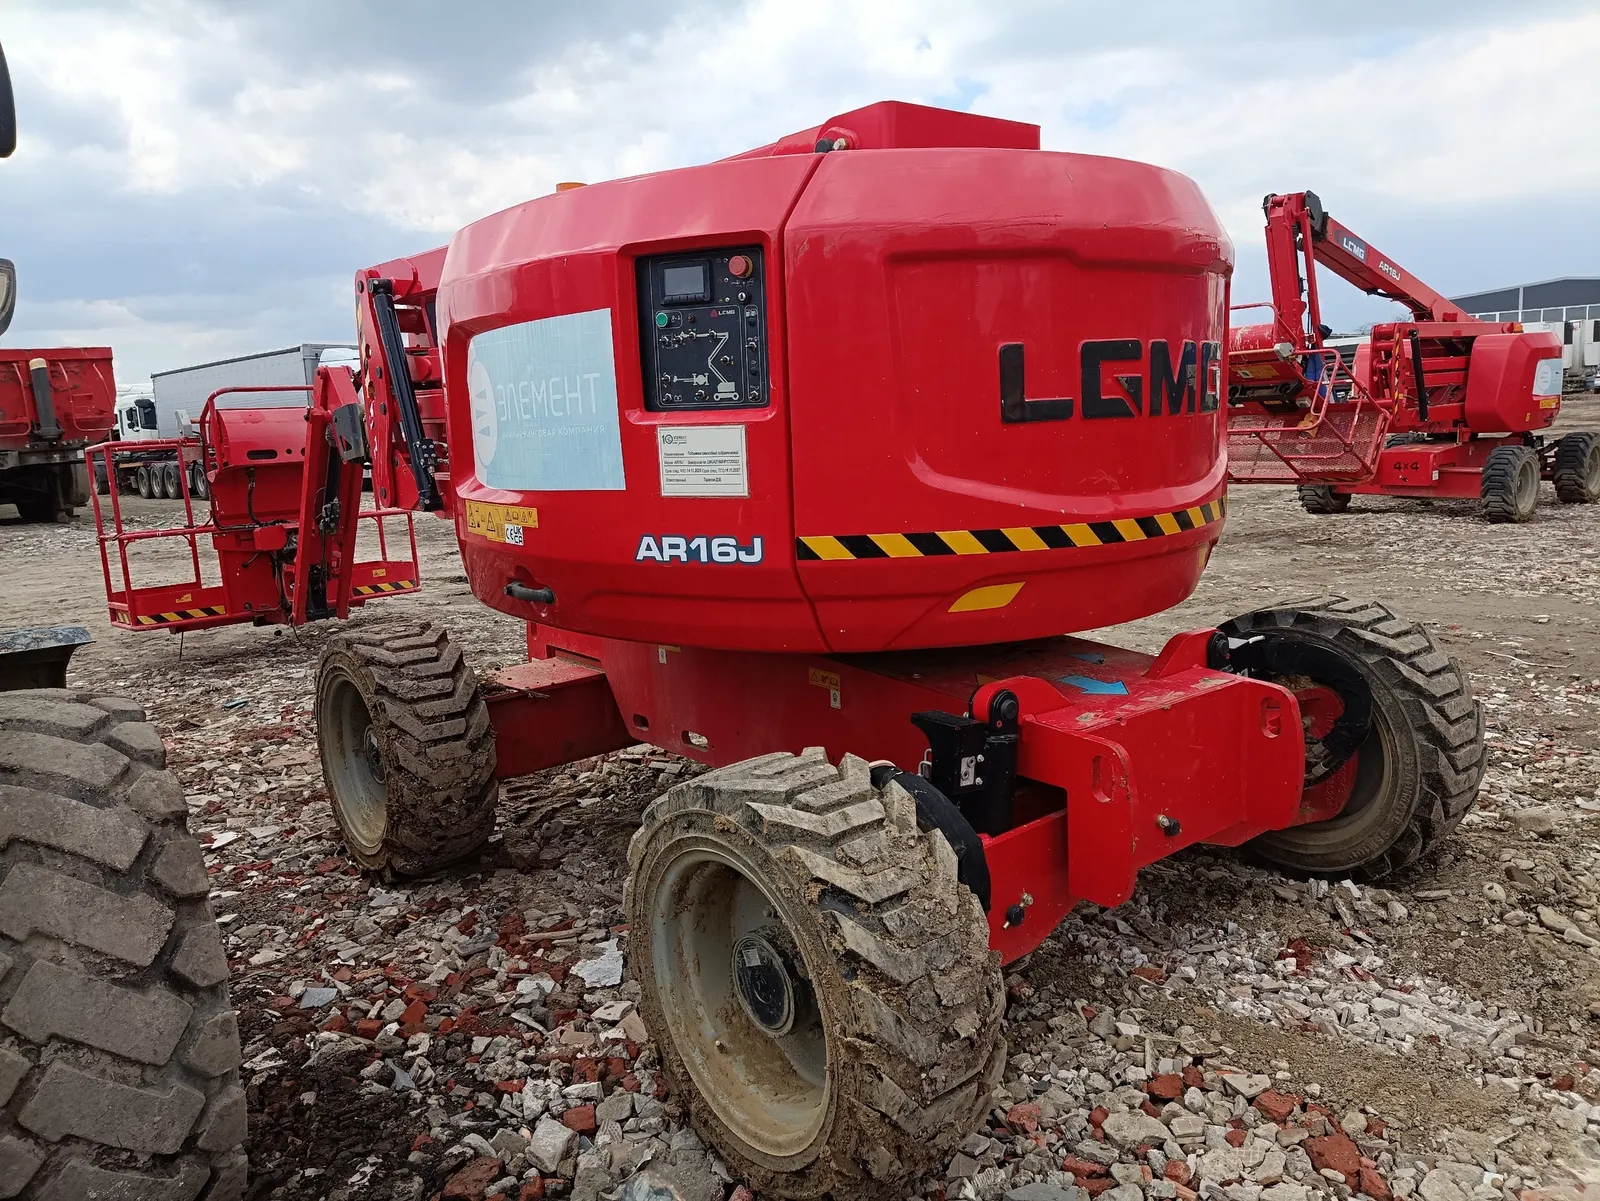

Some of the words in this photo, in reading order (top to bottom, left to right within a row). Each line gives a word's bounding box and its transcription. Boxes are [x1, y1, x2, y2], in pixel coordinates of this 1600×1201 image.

[1378, 260, 1401, 281] AR16J
[496, 372, 600, 422] ЭЛЕМЕНТ
[559, 425, 605, 436] КОМПАНИЯ
[635, 535, 763, 564] AR16J
